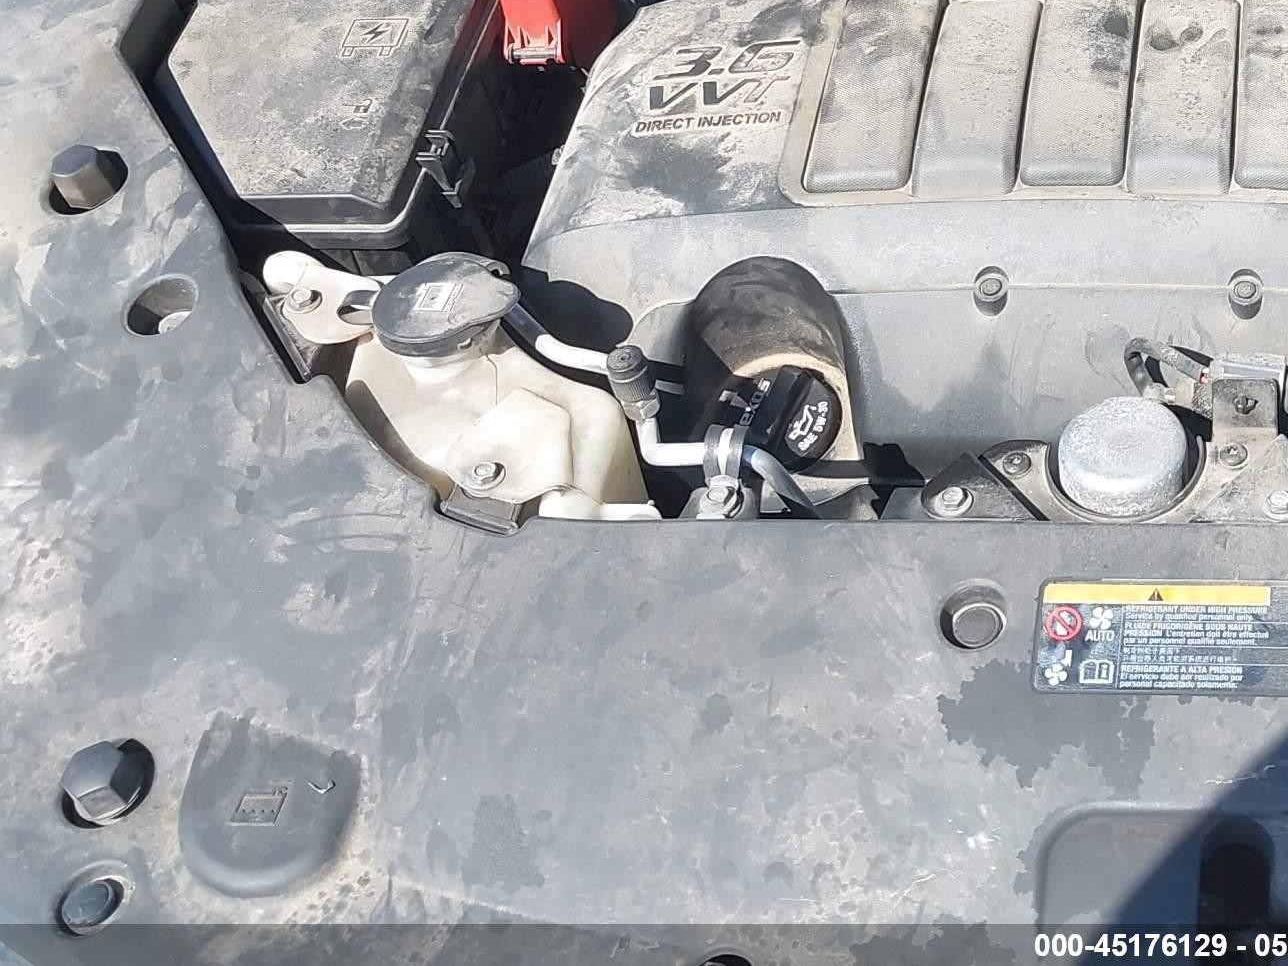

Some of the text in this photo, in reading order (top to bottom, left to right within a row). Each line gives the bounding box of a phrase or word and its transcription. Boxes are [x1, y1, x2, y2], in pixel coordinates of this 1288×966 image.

[652, 39, 801, 81] 3.6
[650, 75, 791, 111] VVT
[635, 111, 782, 134] DIRECT INJECTION
[798, 400, 829, 451] SAE 5W-30
[1180, 605, 1206, 613] UNDER
[1228, 606, 1268, 614] PRESSURE
[1155, 613, 1164, 621] by
[1198, 613, 1234, 622] personnel
[1085, 629, 1115, 642] AUTO
[1149, 637, 1186, 645] personnel
[1121, 665, 1180, 673] REFRIGERANTE
[1180, 665, 1186, 673] A
[1188, 665, 1207, 673] ALTA
